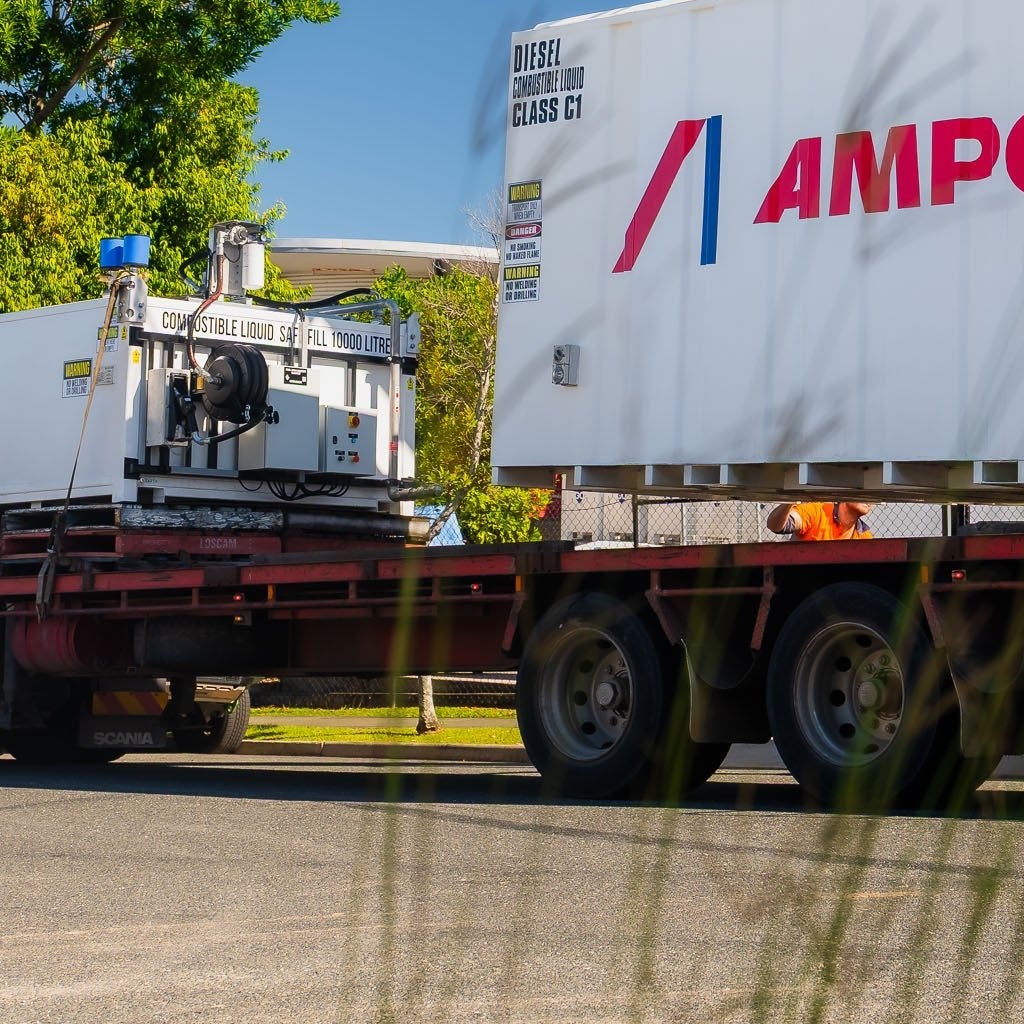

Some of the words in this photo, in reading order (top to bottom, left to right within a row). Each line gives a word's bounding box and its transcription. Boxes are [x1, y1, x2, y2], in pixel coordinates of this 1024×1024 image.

[513, 38, 561, 73] DIESEL
[512, 69, 559, 99] COMBUSTIBLE
[560, 66, 585, 92] LIQUID
[512, 97, 559, 127] CLASS
[564, 94, 582, 120] C1
[510, 183, 540, 201] WARNING
[511, 225, 537, 236] DANGER
[517, 241, 536, 251] SMOKING
[526, 249, 540, 259] FLAME
[505, 265, 539, 280] WARNING
[505, 281, 514, 291] NO
[514, 279, 537, 290] WELDING
[505, 291, 513, 301] OR
[513, 289, 537, 301] DRILLING
[240, 320, 274, 341] LIQUID
[307, 328, 328, 347] FILL
[331, 331, 362, 351] 10000
[65, 361, 90, 378] WARNING
[71, 377, 88, 387] WELDING
[71, 386, 87, 395] DRILLING
[199, 537, 237, 550] LOSCAM
[93, 731, 154, 745] SCANIA
